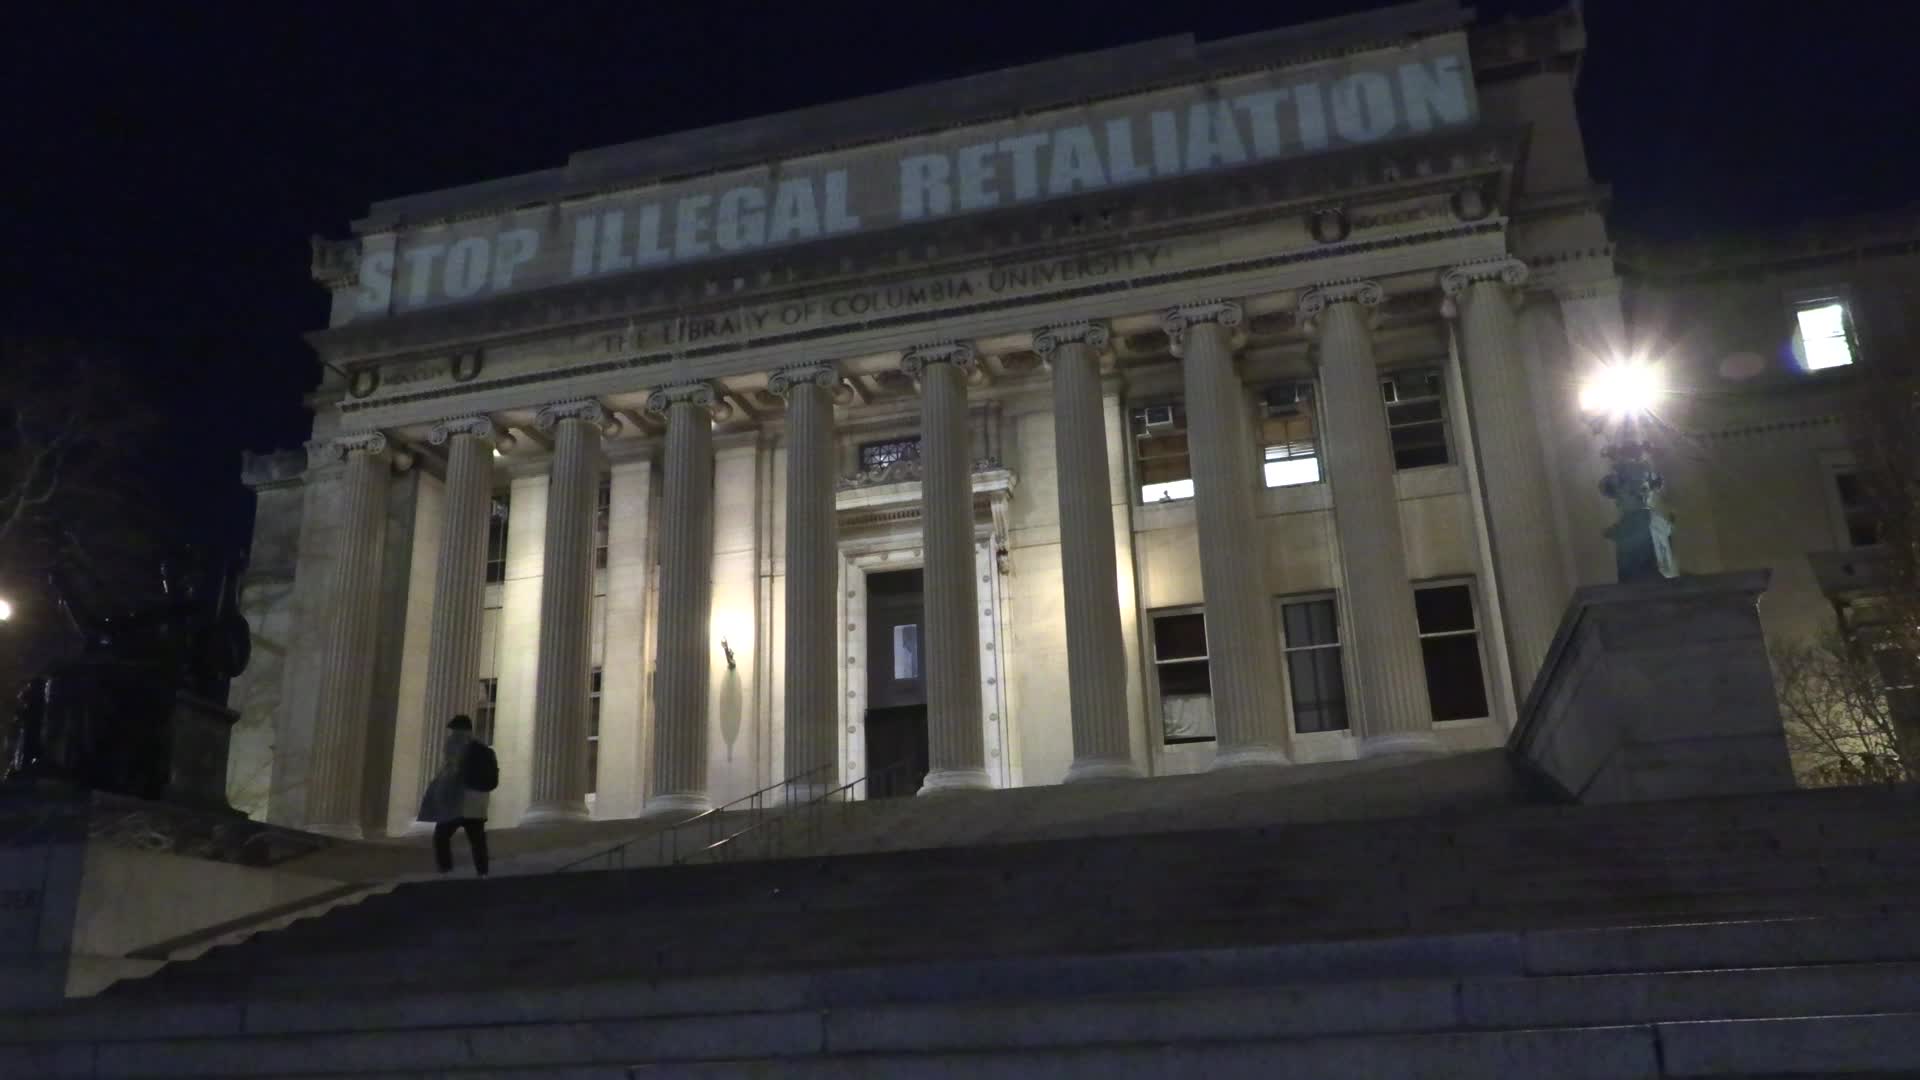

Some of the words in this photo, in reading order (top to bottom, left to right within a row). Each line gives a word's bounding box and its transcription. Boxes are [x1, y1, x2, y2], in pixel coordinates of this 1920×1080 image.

[355, 228, 540, 315] STOP
[571, 170, 860, 278] ILLEGAL
[899, 54, 1472, 222] RETALIATION
[779, 303, 818, 326] OF
[831, 276, 974, 317] COLUMBIA
[989, 245, 1161, 293] UNIVERSITY
